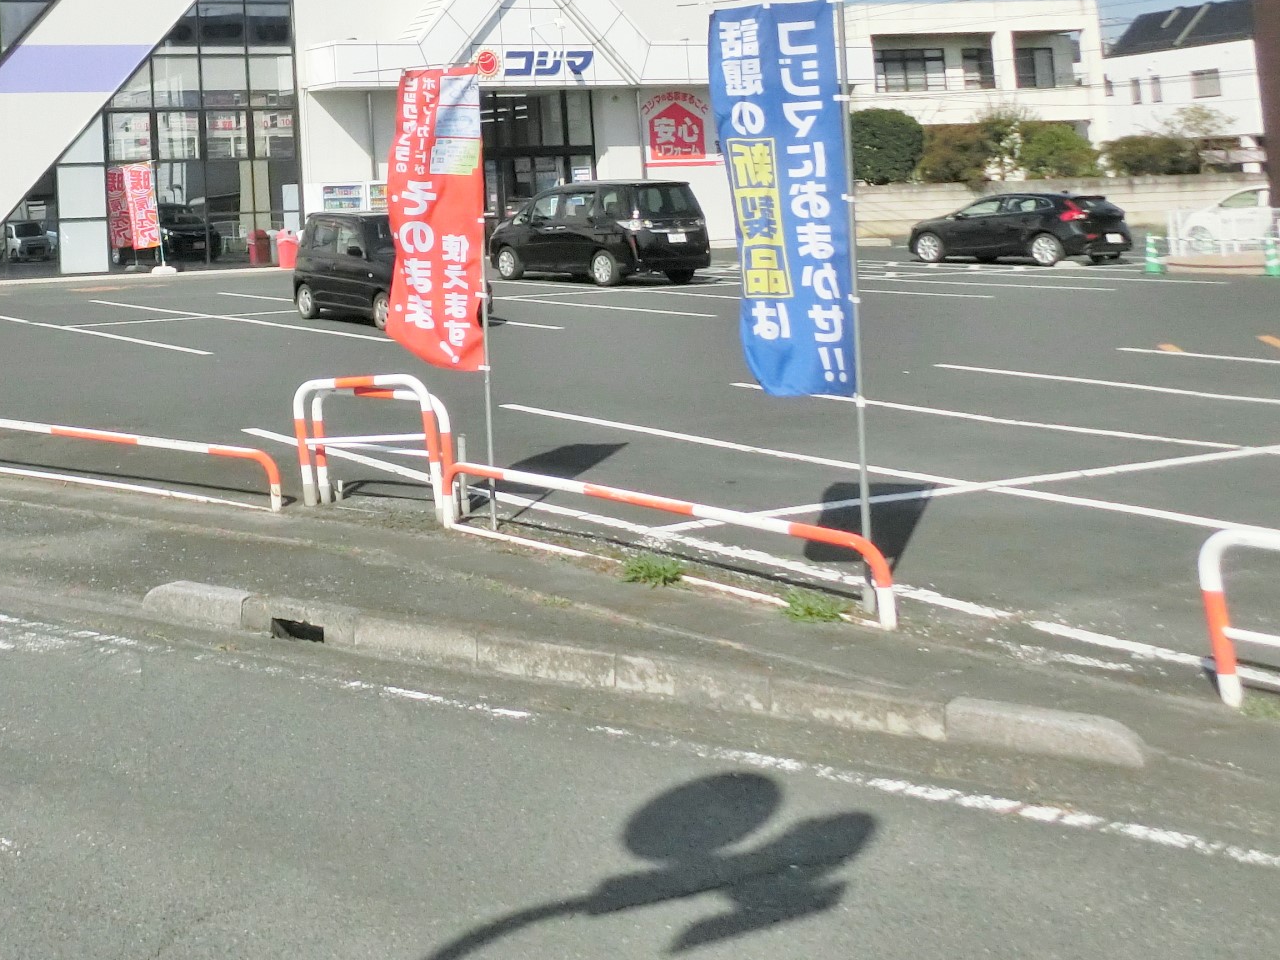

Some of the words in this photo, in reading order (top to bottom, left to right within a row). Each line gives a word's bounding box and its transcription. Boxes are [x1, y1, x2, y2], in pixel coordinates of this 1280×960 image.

[504, 50, 594, 76] コジマ
[653, 117, 699, 144] 安心
[655, 144, 700, 156] リフォーム
